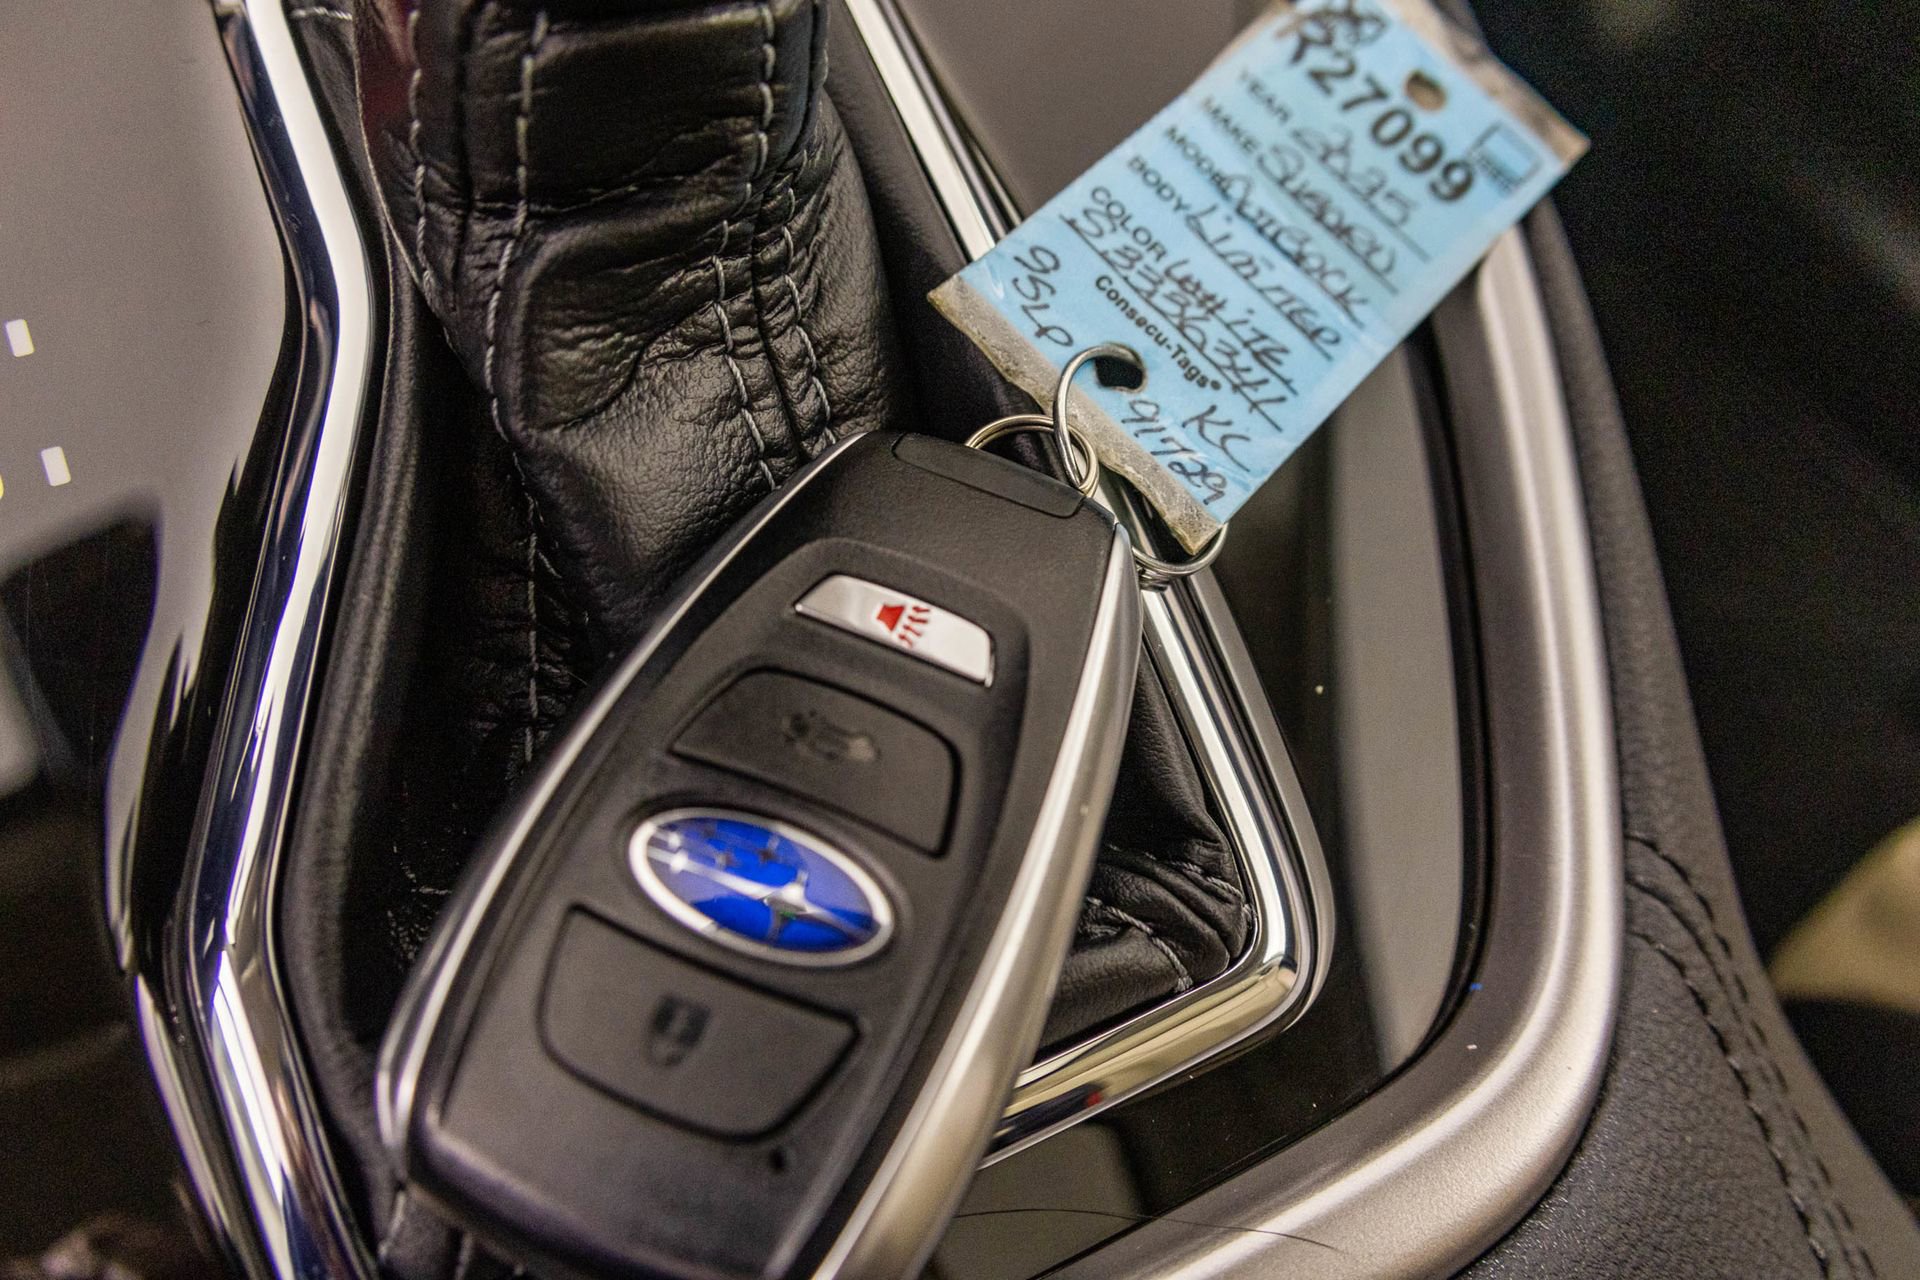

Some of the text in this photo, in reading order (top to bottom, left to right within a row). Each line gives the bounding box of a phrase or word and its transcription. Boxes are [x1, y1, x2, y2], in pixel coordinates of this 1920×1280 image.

[1204, 99, 1258, 152] MAKE
[1127, 155, 1189, 213] BODY
[1091, 186, 1167, 262] COLOR
[1182, 404, 1251, 472] KC
